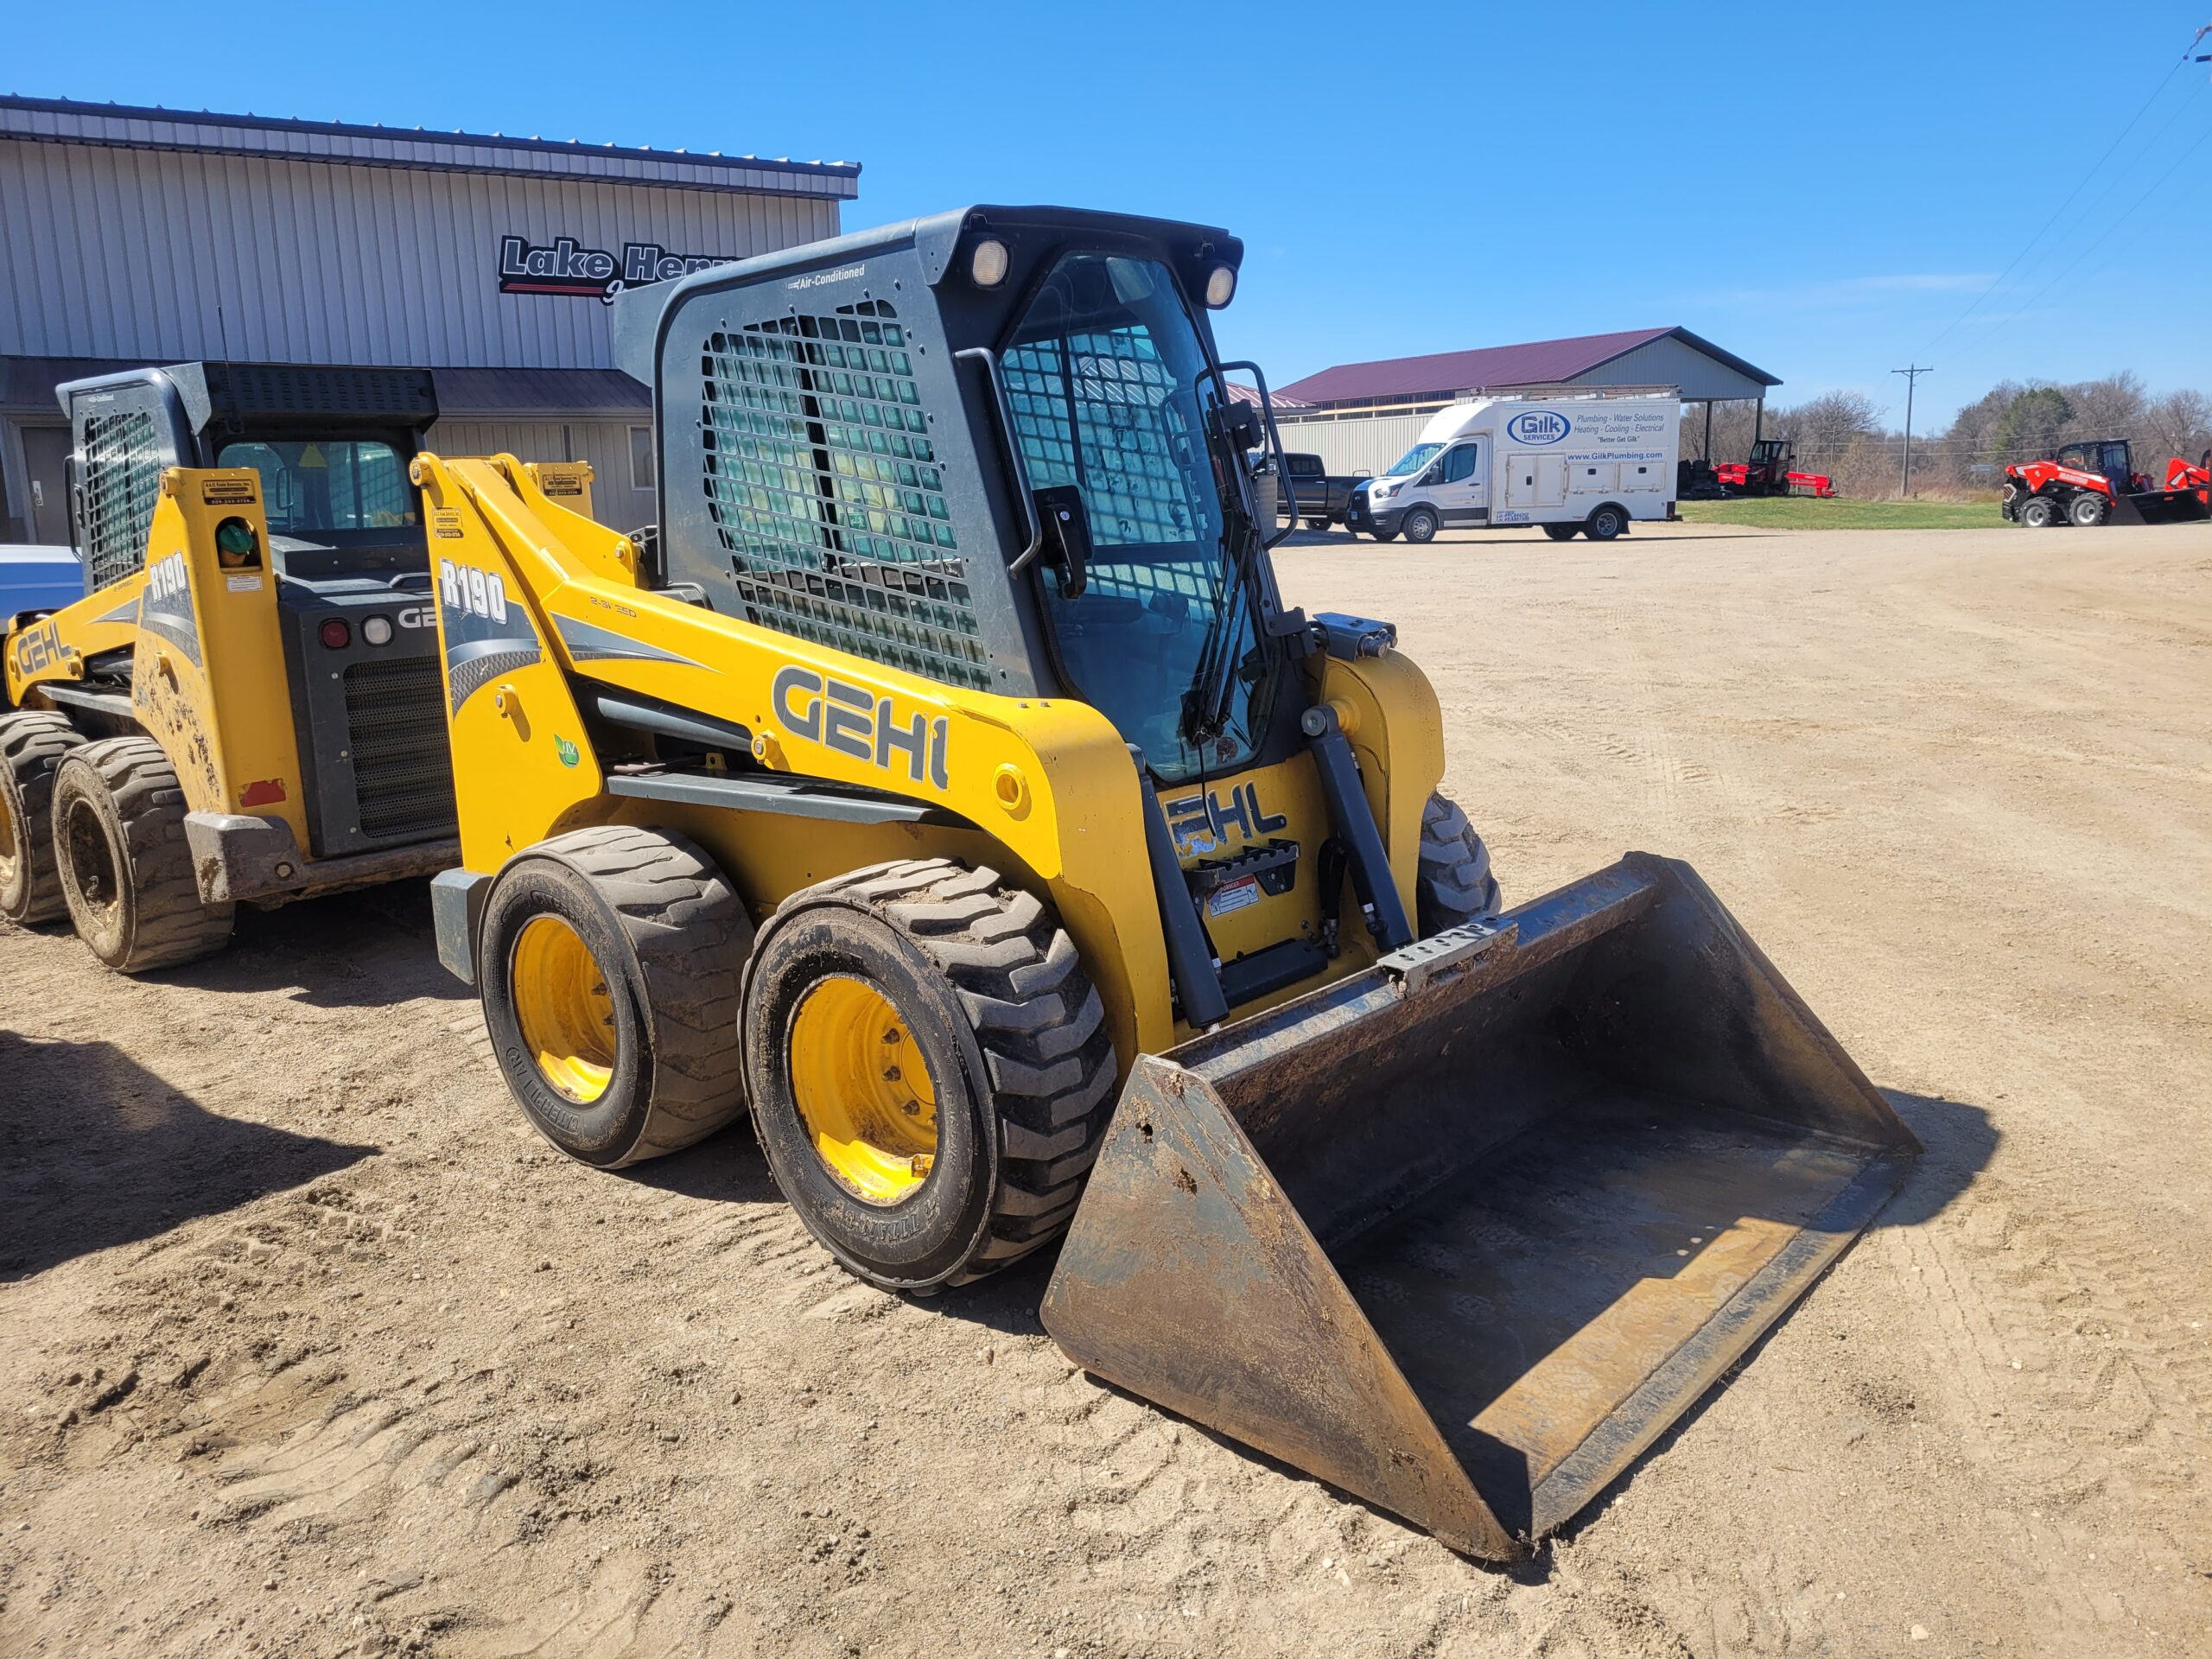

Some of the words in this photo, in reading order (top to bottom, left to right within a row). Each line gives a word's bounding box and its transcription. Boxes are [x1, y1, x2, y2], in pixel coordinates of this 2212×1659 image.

[502, 238, 613, 279] Lake
[799, 264, 865, 289] Air-Conditioned
[1521, 416, 1560, 434] Gilk
[1577, 415, 1608, 423] Plumbing
[1614, 414, 1632, 423] Water
[1634, 413, 1664, 422] Solutions
[1574, 426, 1599, 435] Heating
[1605, 425, 1630, 434] Cooling
[1635, 423, 1664, 432] Electrical
[1567, 452, 1663, 461] www.GilkPlumbing.com
[150, 551, 187, 603] R190
[440, 557, 509, 626] R190
[17, 620, 72, 675] GEHL
[1223, 881, 1240, 891] DANGER
